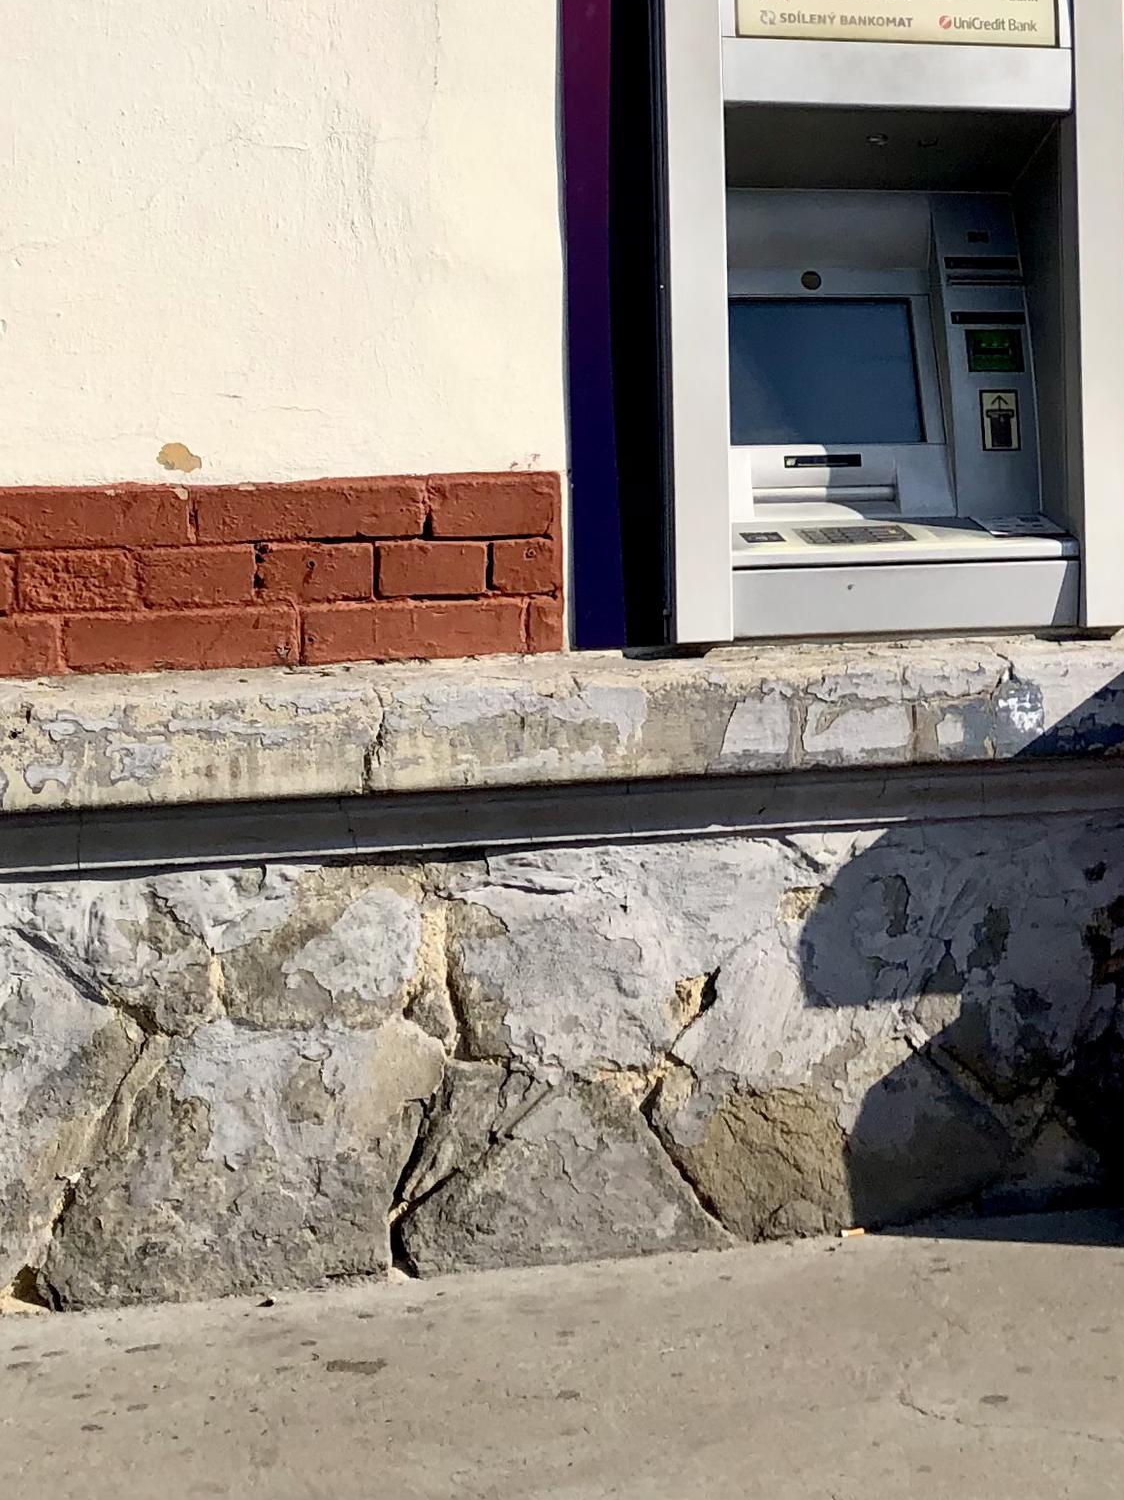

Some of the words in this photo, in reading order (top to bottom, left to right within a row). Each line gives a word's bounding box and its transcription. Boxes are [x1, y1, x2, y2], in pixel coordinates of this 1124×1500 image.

[779, 10, 837, 26] SDÍLENÝ
[839, 14, 913, 29] BANKOMAT
[953, 16, 1006, 31] UniCredit
[1008, 18, 1038, 32] Bank
